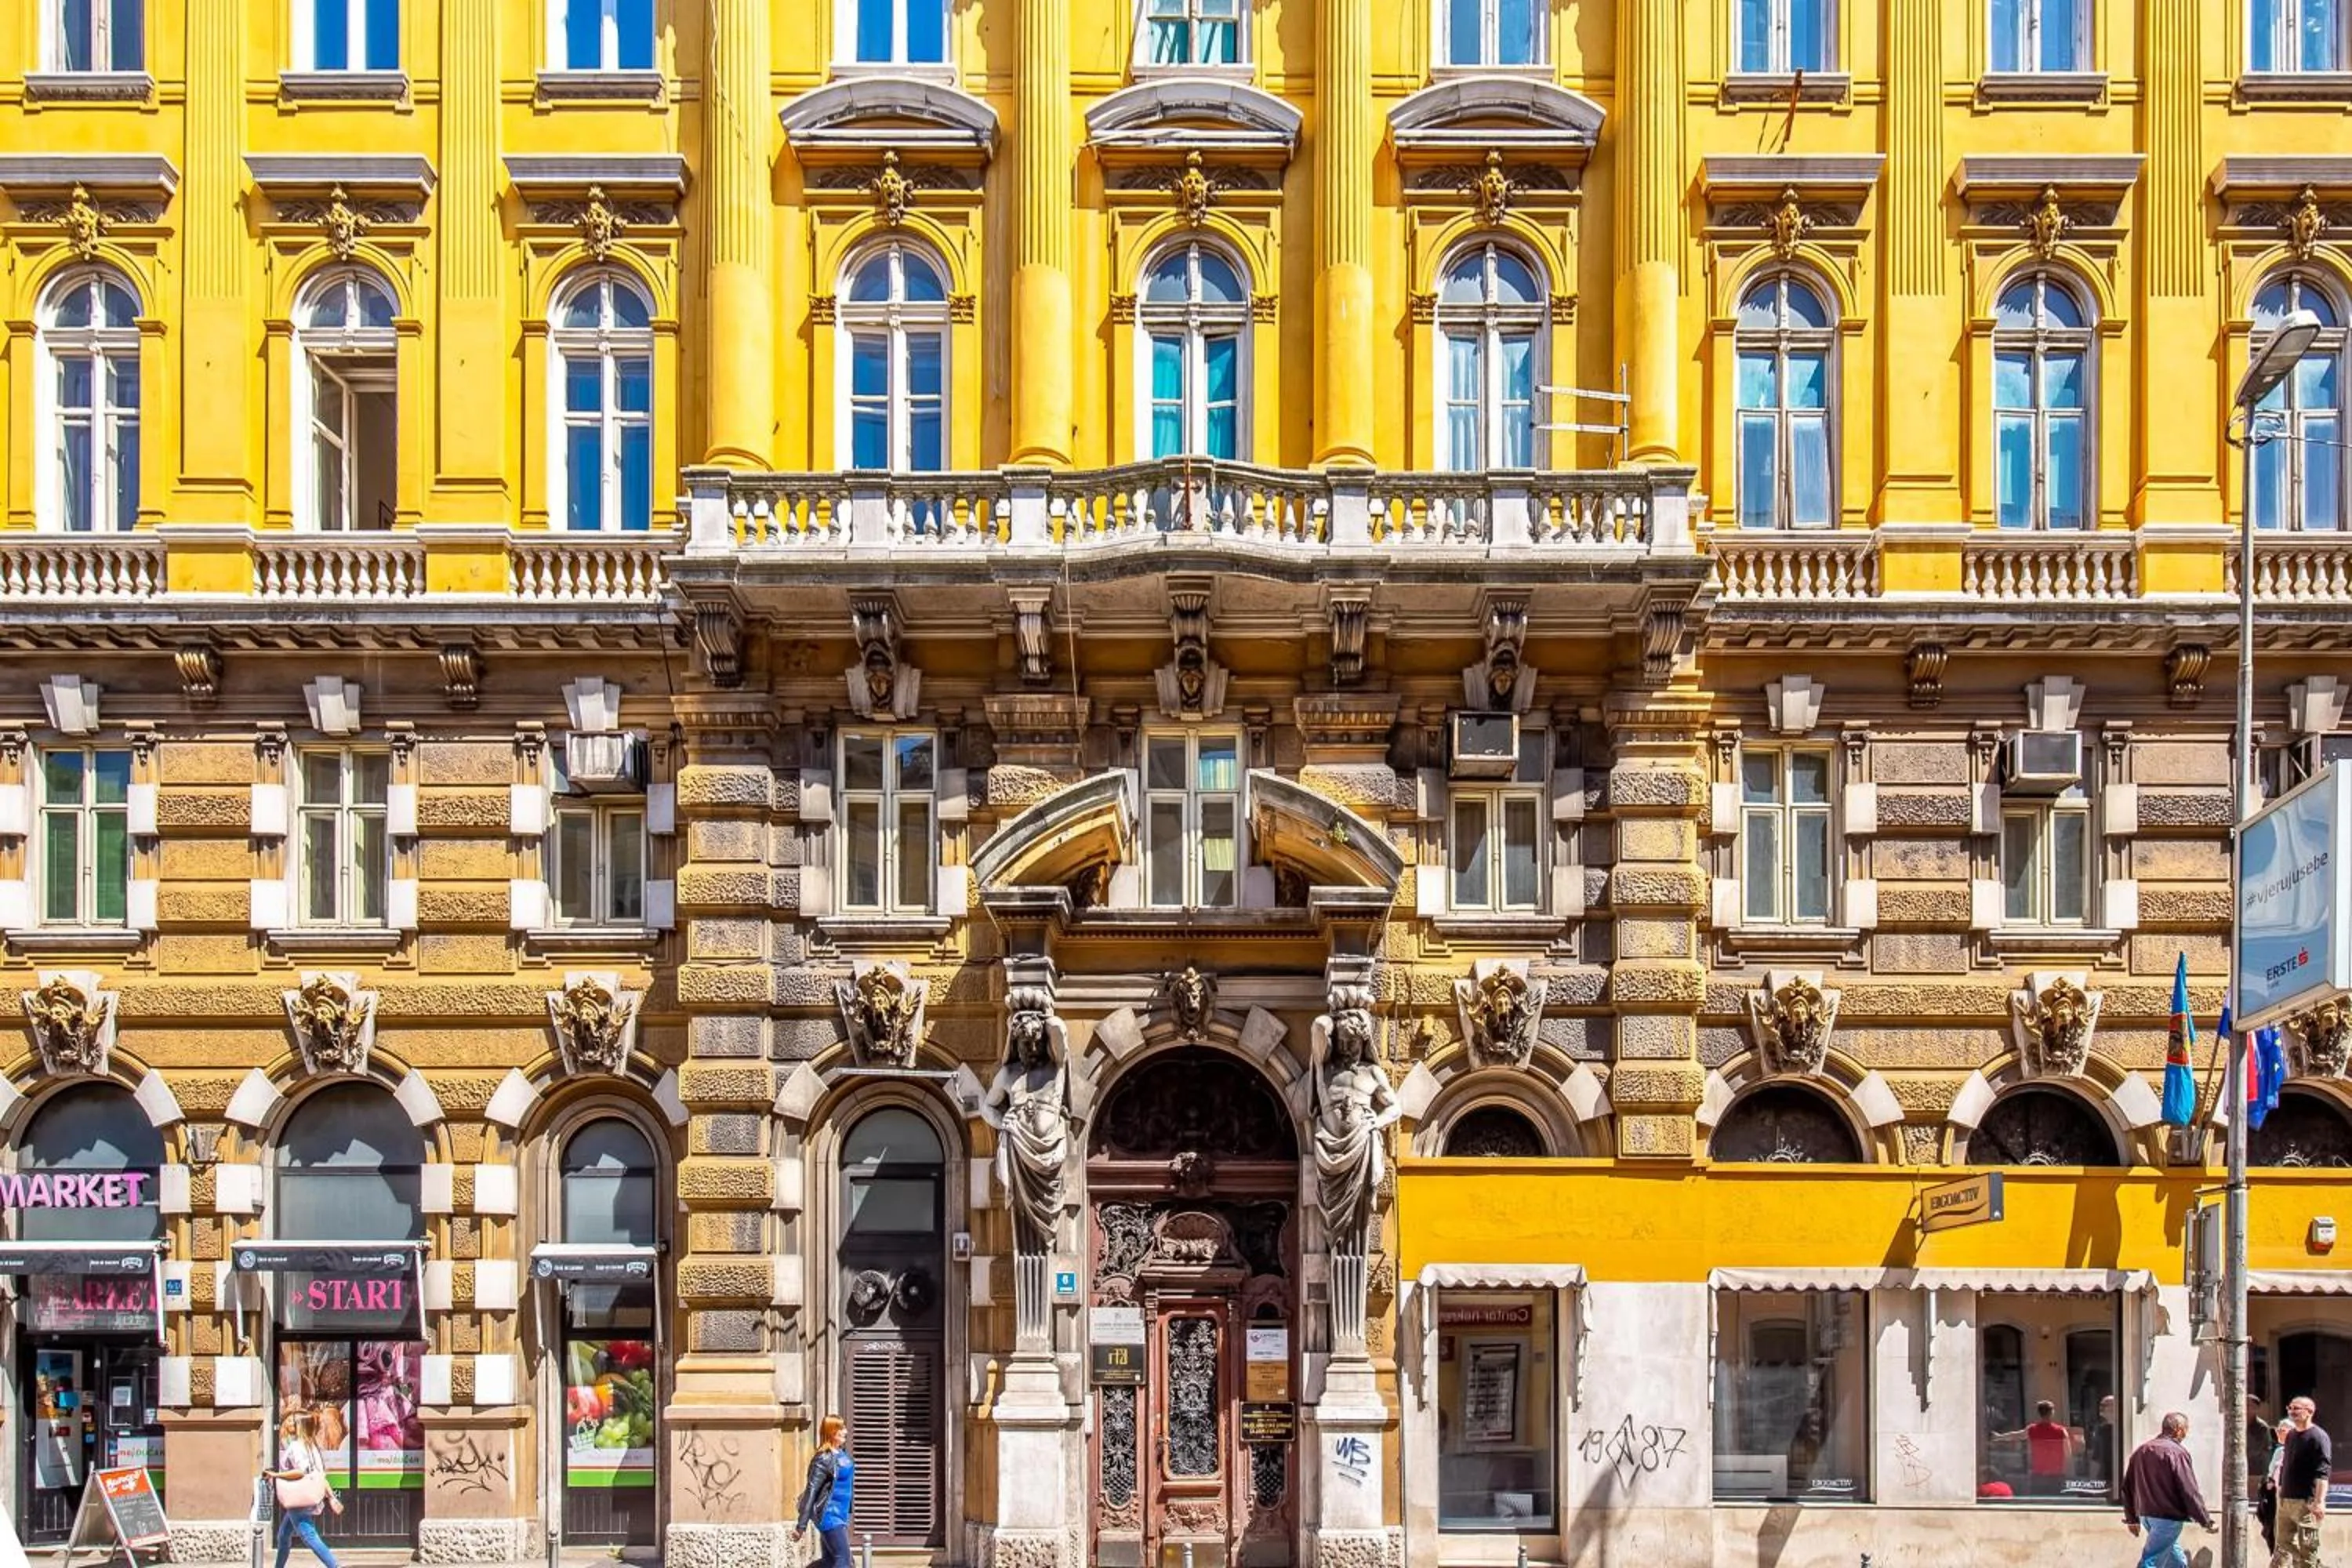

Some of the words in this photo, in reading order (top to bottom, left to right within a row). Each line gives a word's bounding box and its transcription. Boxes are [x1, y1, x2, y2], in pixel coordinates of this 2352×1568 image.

[2245, 851, 2328, 906] #vjerujusebe
[2267, 956, 2297, 981] ERSTE
[0, 1173, 143, 1207] MARKET
[307, 1279, 406, 1311] START
